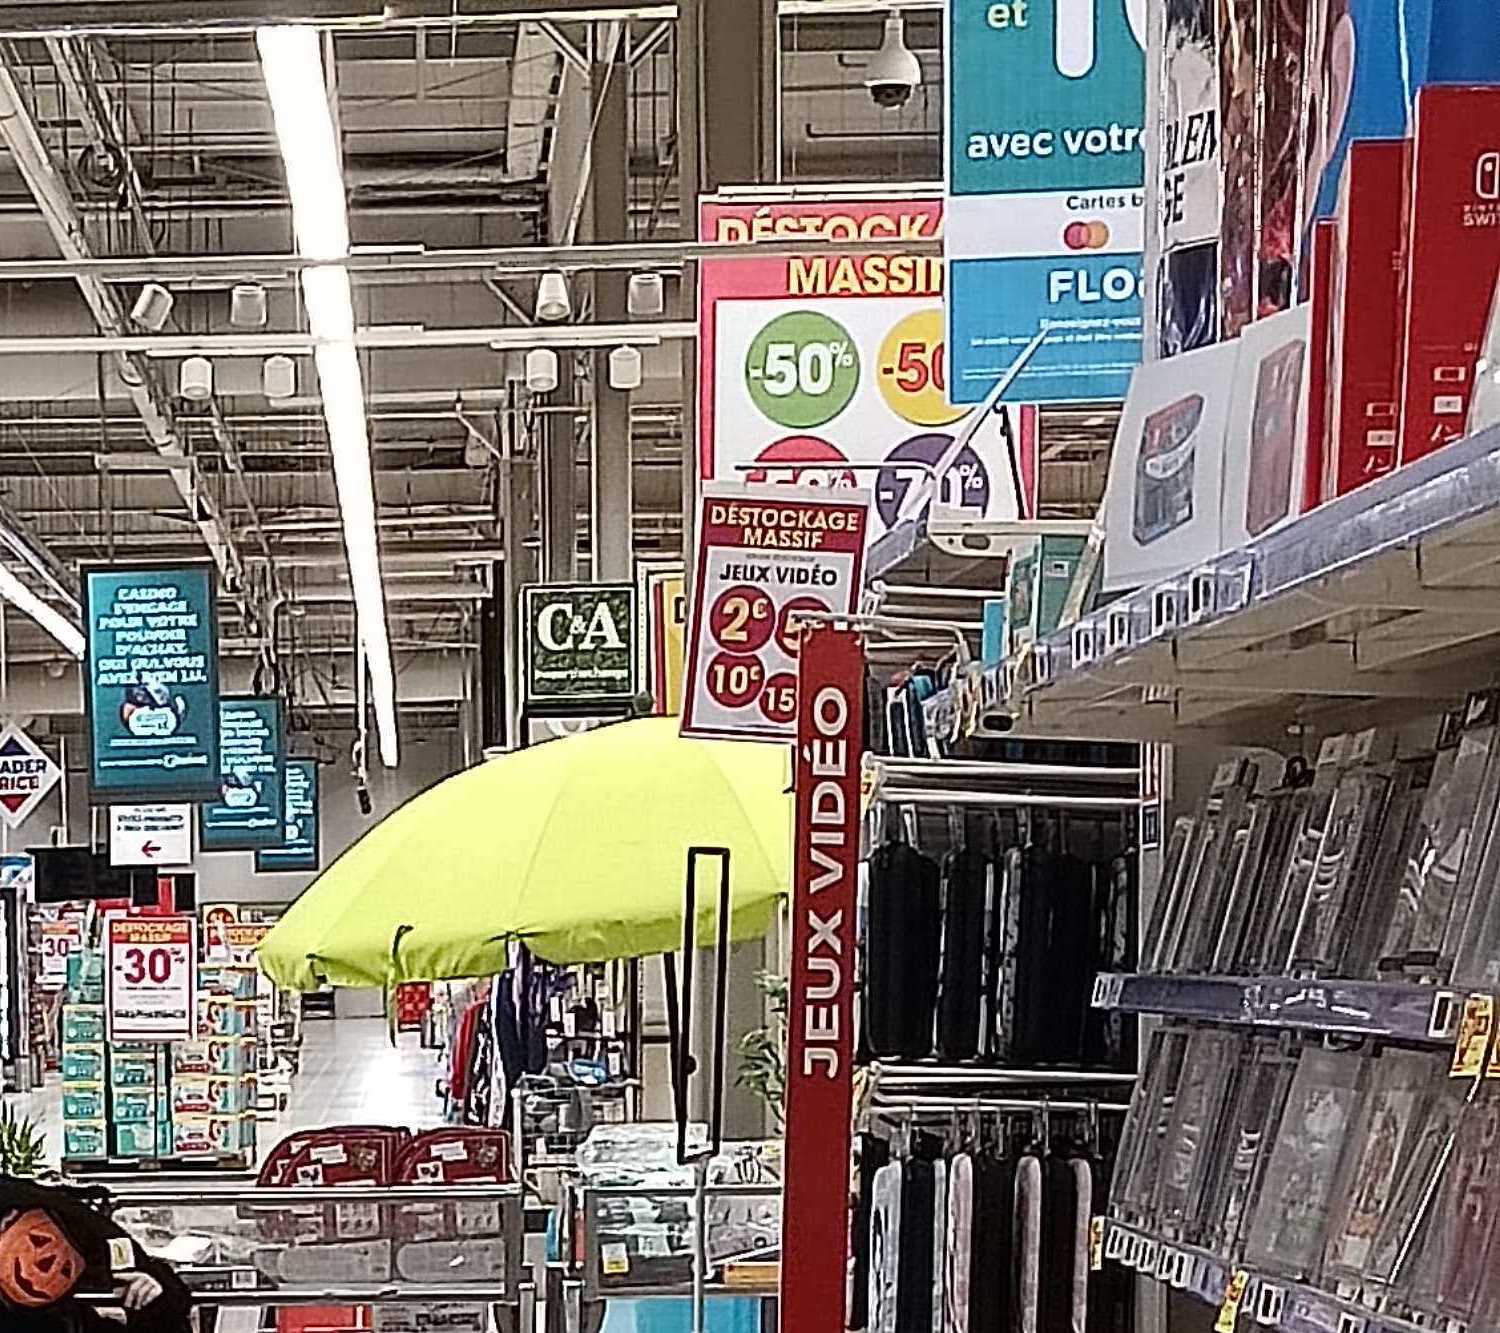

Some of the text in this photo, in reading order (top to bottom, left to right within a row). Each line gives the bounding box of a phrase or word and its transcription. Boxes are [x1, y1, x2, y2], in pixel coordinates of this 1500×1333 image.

[987, 1, 1027, 28] et
[967, 131, 1054, 159] avec
[1066, 194, 1126, 212] Cartes
[717, 205, 945, 243] DÉSTOCK
[1463, 212, 1500, 227] SWI
[748, 340, 853, 397] -50%
[711, 502, 859, 531] DÉSTOCKAGE
[743, 527, 823, 548] MASSIF
[719, 563, 838, 587] JEUX VIDÉO
[537, 602, 628, 651] C&A
[803, 686, 848, 1079] JEUX VIDÉO
